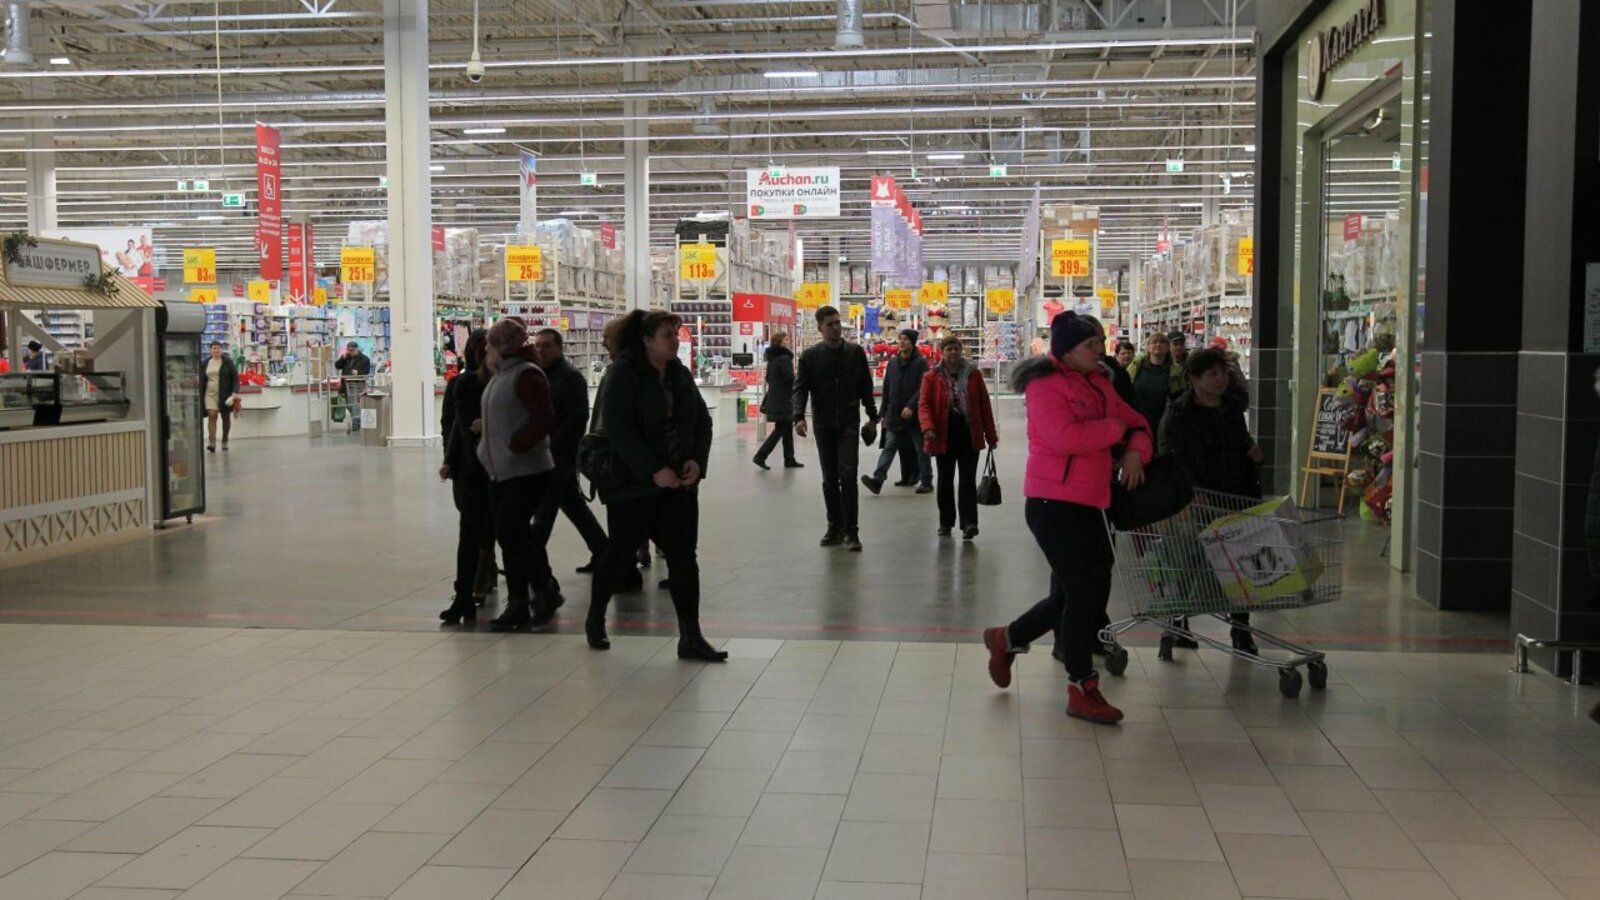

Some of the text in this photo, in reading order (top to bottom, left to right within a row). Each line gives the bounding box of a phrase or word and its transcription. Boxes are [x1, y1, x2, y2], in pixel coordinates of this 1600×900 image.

[759, 172, 829, 185] Auchan.ru
[750, 186, 837, 197] ПОКУПКИ ОНЛАЙН
[197, 267, 208, 282] 83
[349, 266, 365, 281] 251
[520, 264, 532, 280] 25
[690, 263, 707, 278] 113
[1060, 260, 1079, 275] 399
